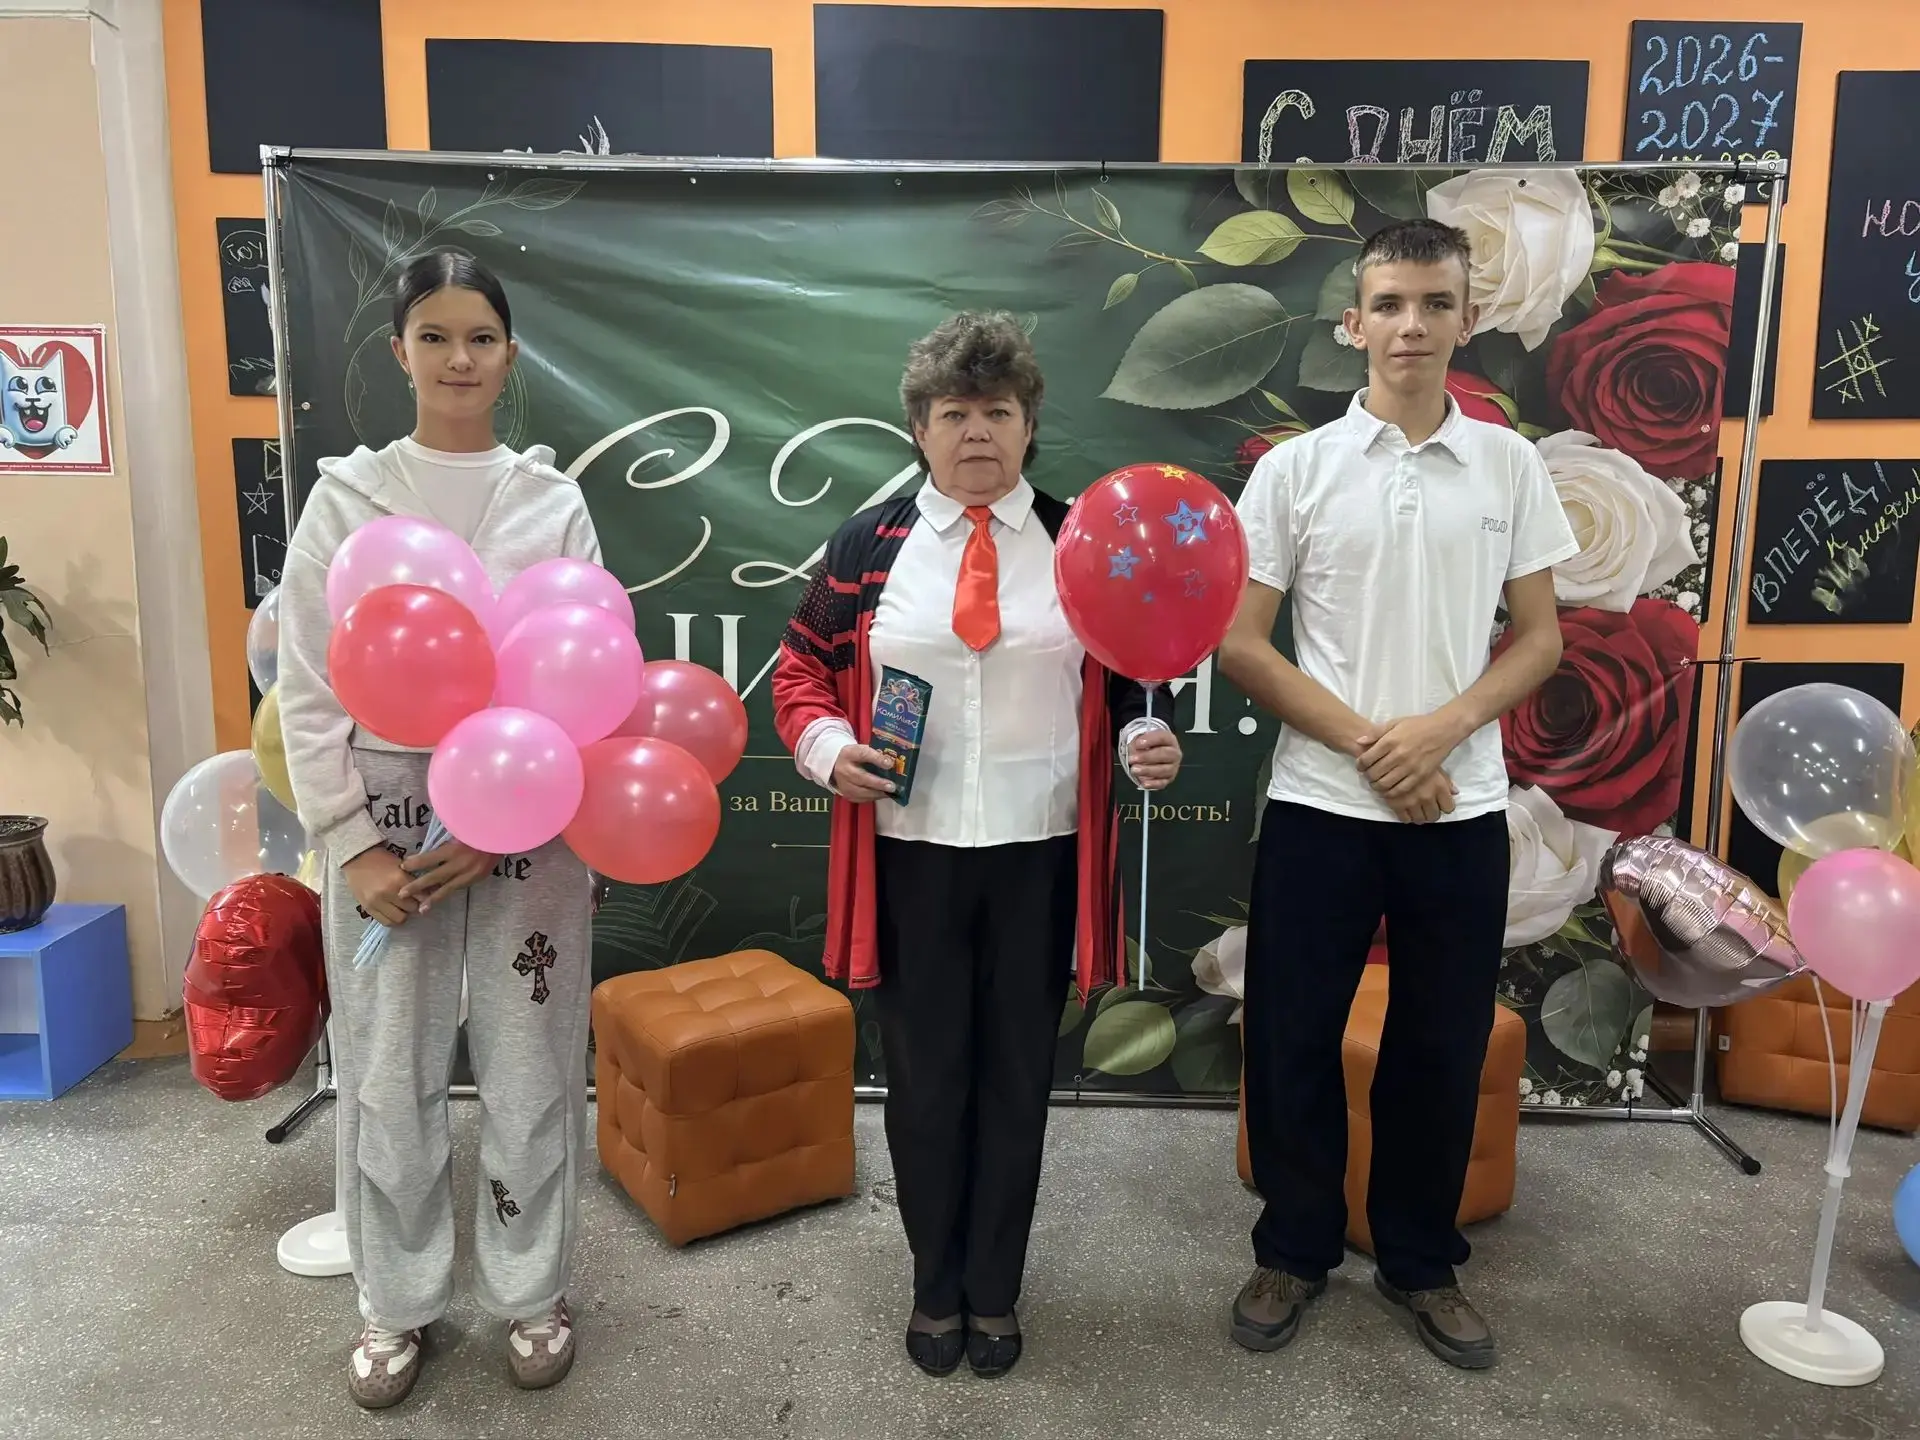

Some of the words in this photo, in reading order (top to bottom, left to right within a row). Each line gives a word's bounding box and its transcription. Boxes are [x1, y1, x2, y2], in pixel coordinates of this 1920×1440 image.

[1639, 32, 1784, 96] 2026-
[1636, 88, 1784, 152] 2027
[1480, 516, 1508, 533] POLO
[1752, 461, 1892, 613] ВПЕРЁД!
[729, 796, 760, 812] за
